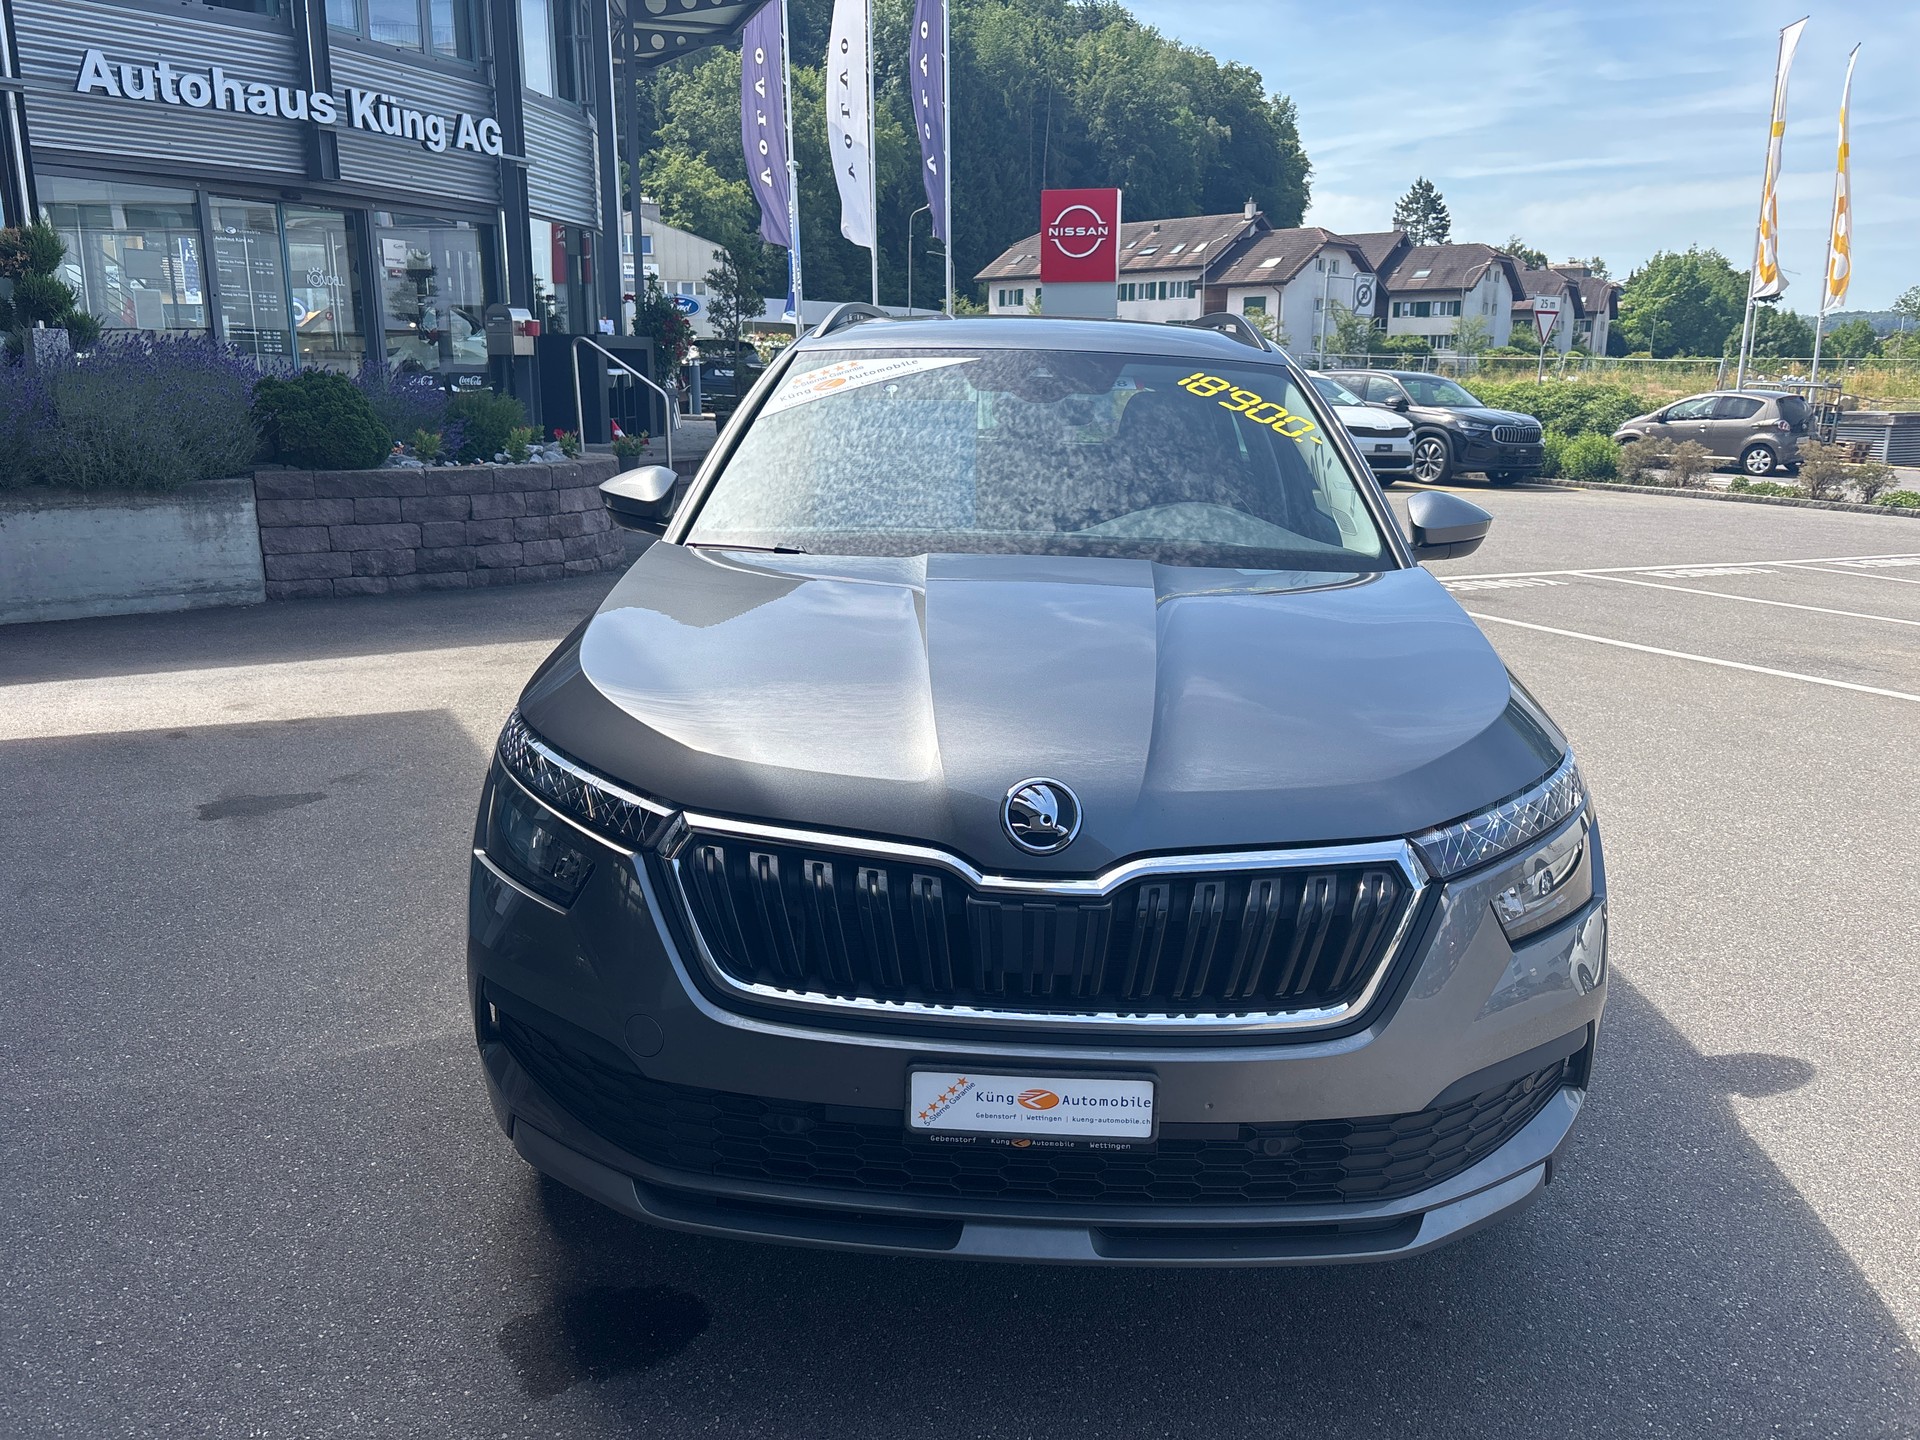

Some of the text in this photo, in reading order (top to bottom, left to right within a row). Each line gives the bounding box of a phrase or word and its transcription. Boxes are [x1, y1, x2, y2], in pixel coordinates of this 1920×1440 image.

[76, 49, 503, 156] Autohaus Küng AG
[1048, 226, 1109, 237] NISSAN
[1540, 299, 1556, 309] 25 m
[829, 365, 865, 379] Garantie
[779, 388, 812, 403] Küng
[848, 359, 919, 381] Automobile
[924, 1082, 976, 1127] 5-Sterne Garantie
[976, 1091, 1152, 1108] Küng Automobile
[975, 1112, 1151, 1125] Gebenstorf Wettingen kueng-automobile.ch
[930, 1135, 1131, 1150] Gebenstorf Küng Automobile Wettingen
